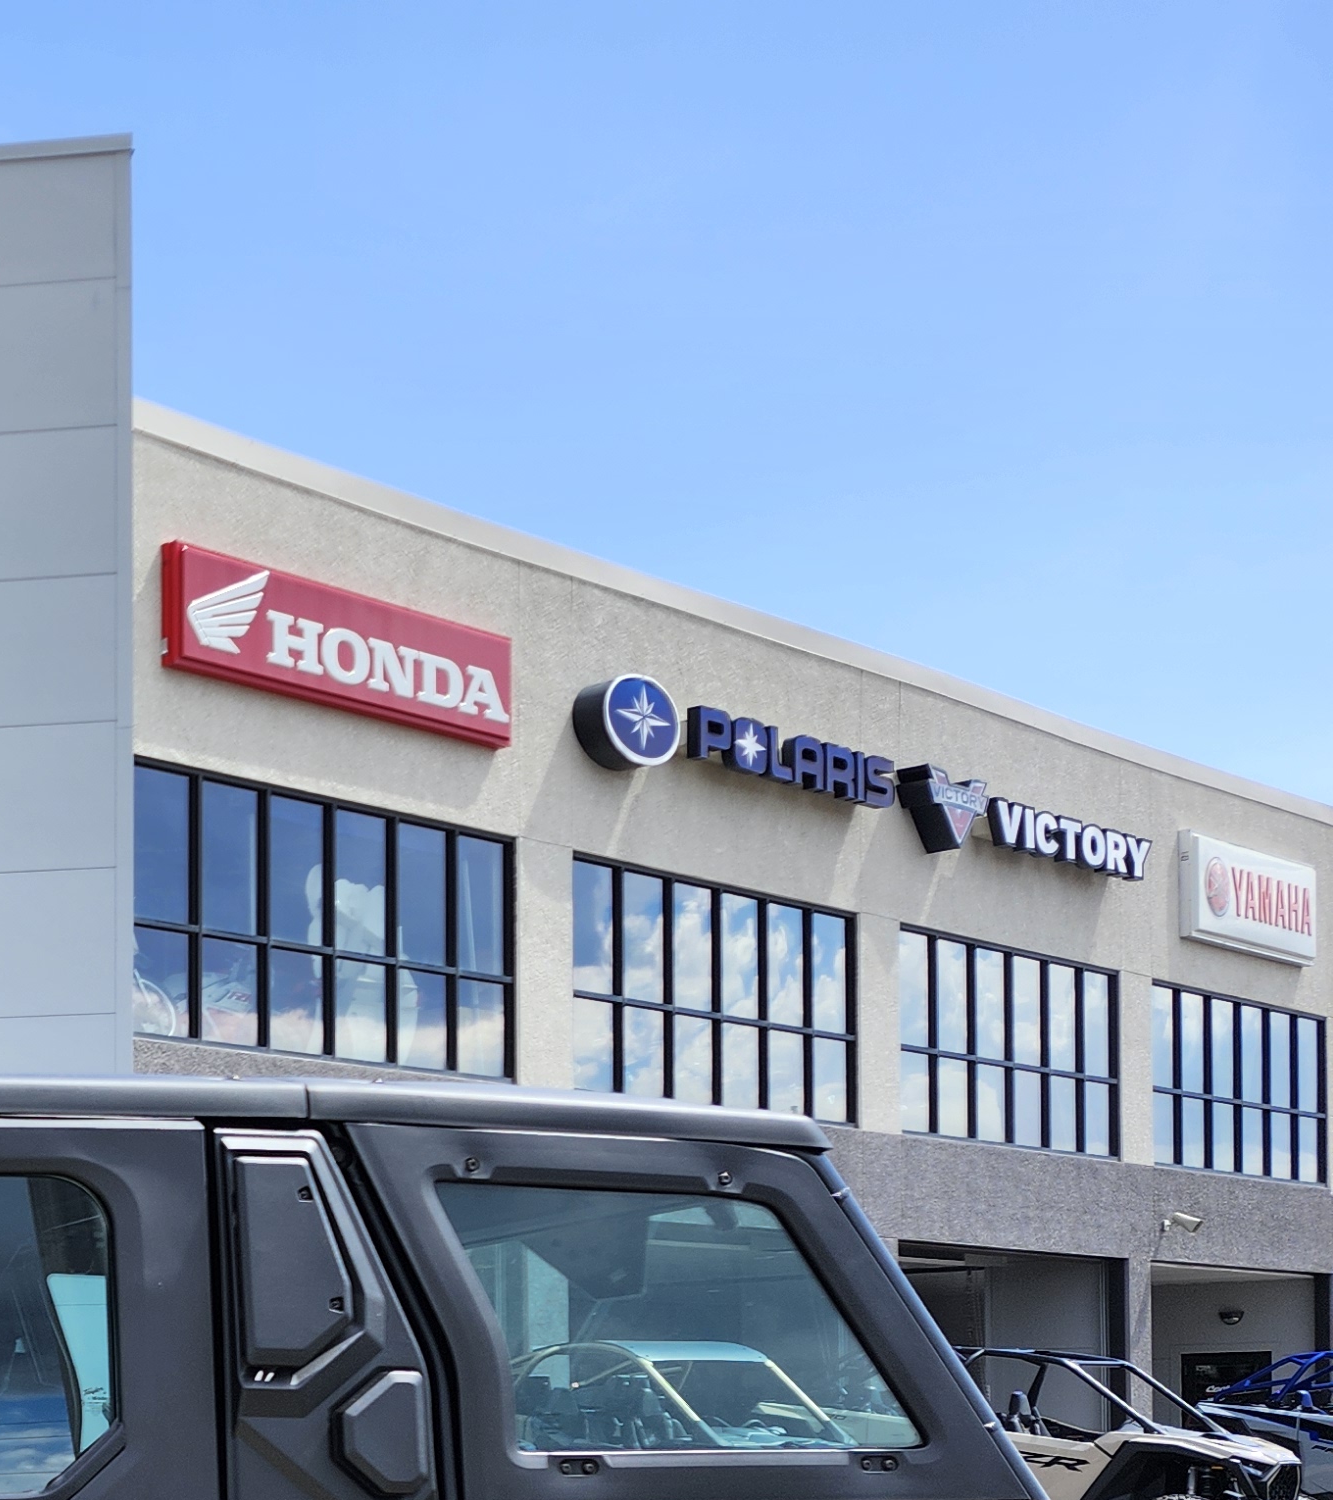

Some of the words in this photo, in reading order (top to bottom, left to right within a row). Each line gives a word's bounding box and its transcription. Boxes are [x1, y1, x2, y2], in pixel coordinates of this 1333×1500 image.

[265, 608, 510, 723] HONDA
[687, 705, 896, 809] POLARIS
[932, 785, 986, 810] VICTORY
[988, 797, 1153, 880] VICTORY
[1231, 866, 1313, 936] YAMAHA
